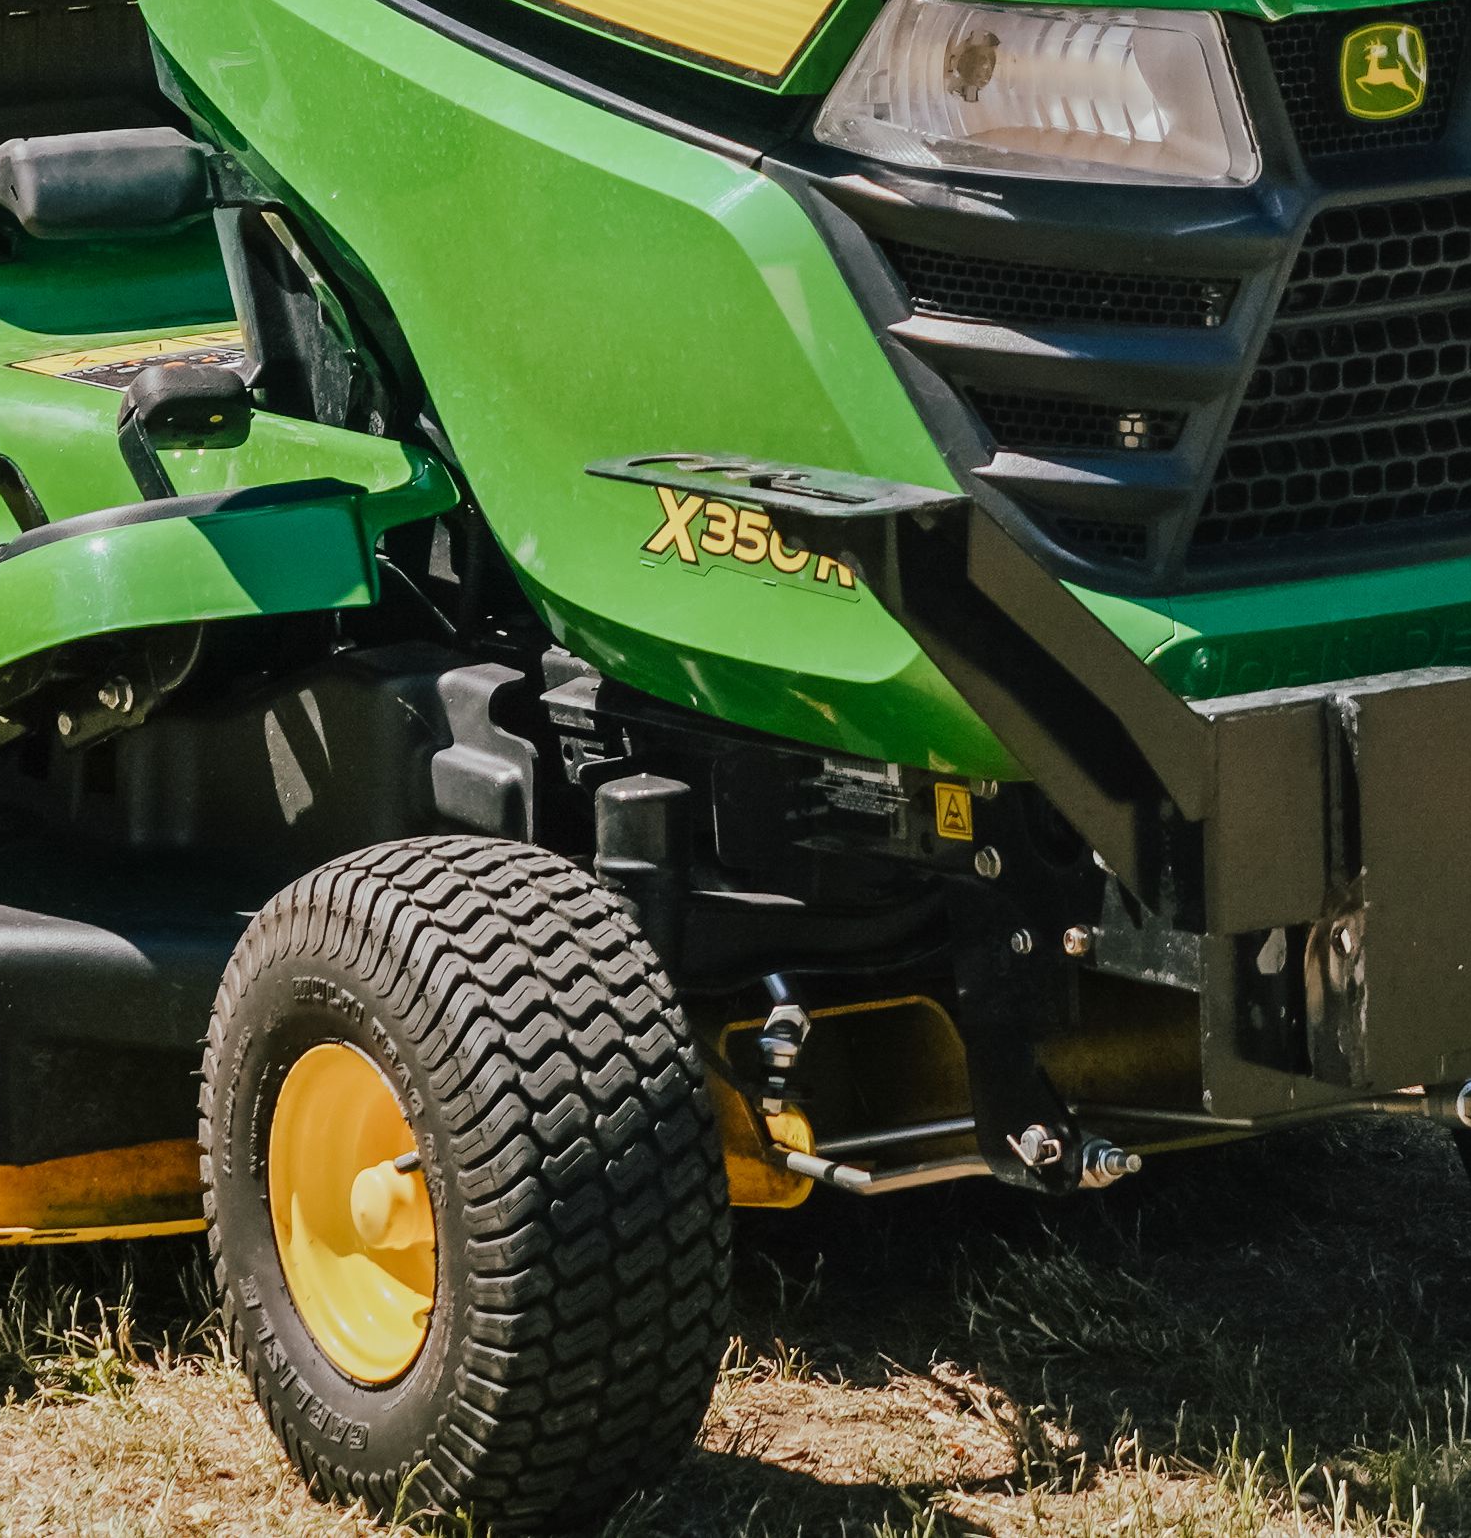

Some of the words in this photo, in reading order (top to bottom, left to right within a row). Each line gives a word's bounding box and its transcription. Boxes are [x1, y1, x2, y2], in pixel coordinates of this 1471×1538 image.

[292, 975, 365, 1023] MULTI
[370, 1016, 425, 1117] TRAC
[238, 1274, 370, 1451] CARLISLE
